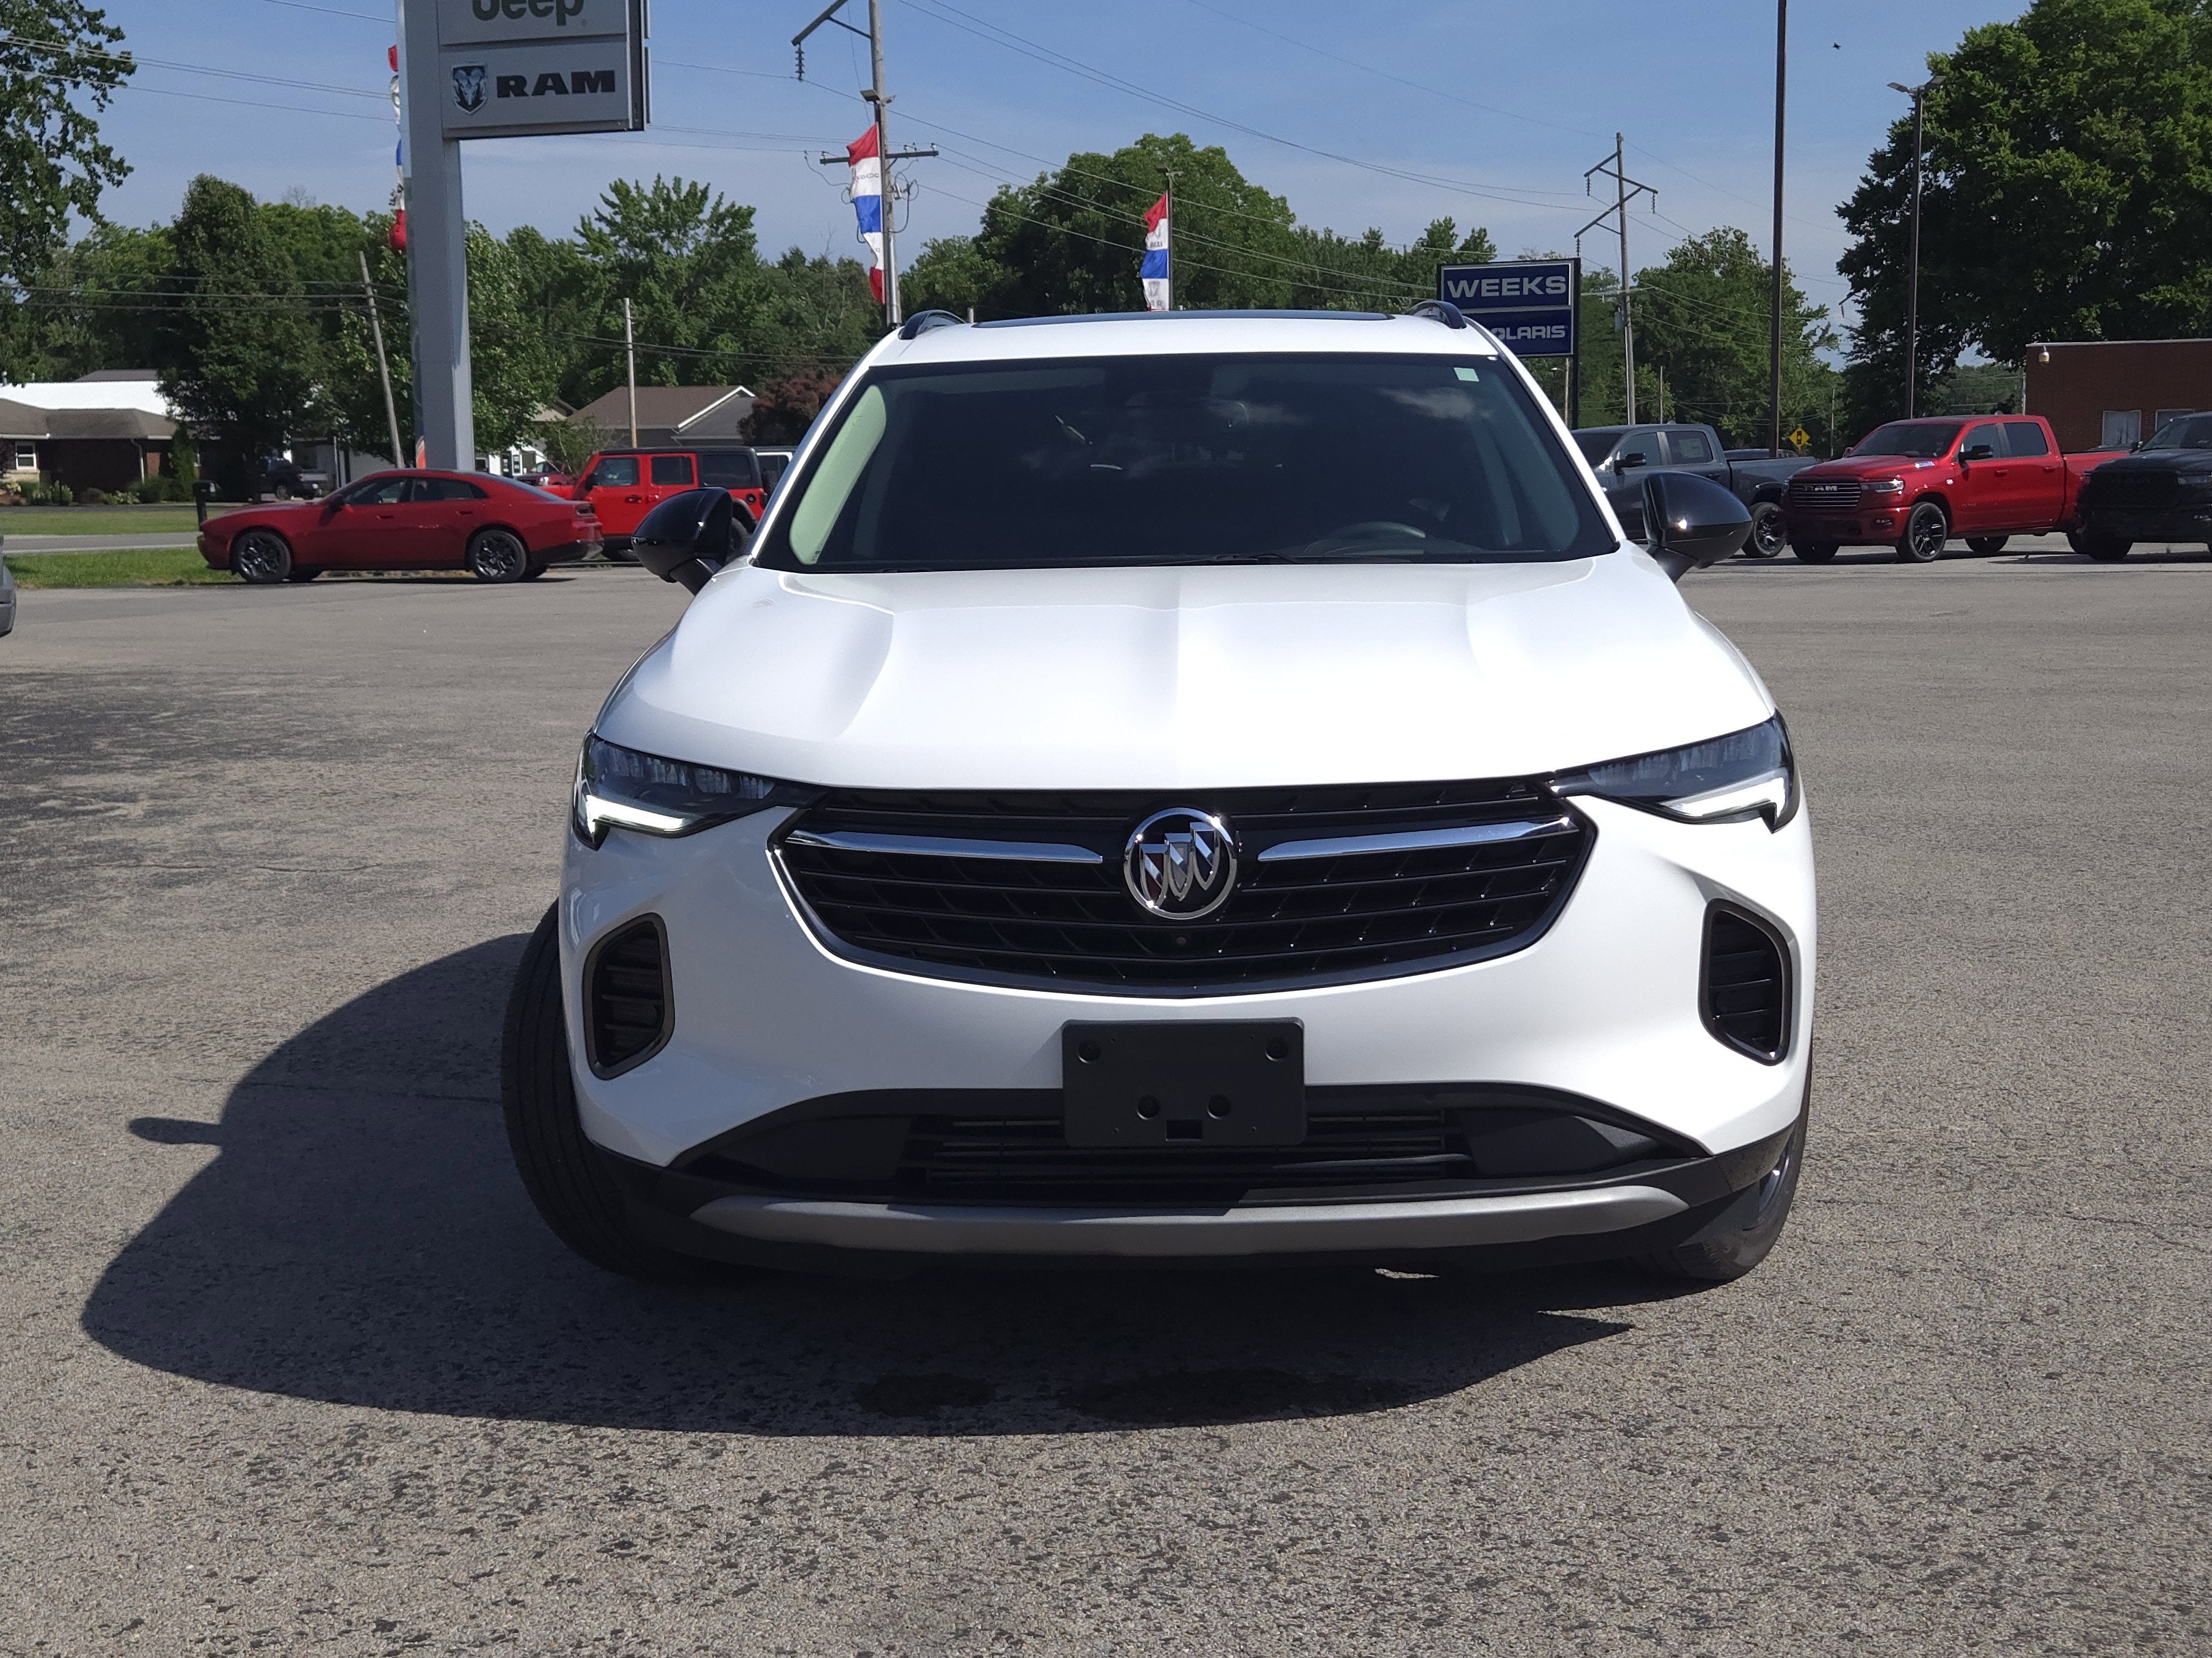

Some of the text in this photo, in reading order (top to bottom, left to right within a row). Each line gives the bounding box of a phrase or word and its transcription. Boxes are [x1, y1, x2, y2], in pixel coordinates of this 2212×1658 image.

[496, 70, 616, 98] RAM
[1447, 276, 1566, 298] WEEKS
[1491, 325, 1566, 340] OLARIS
